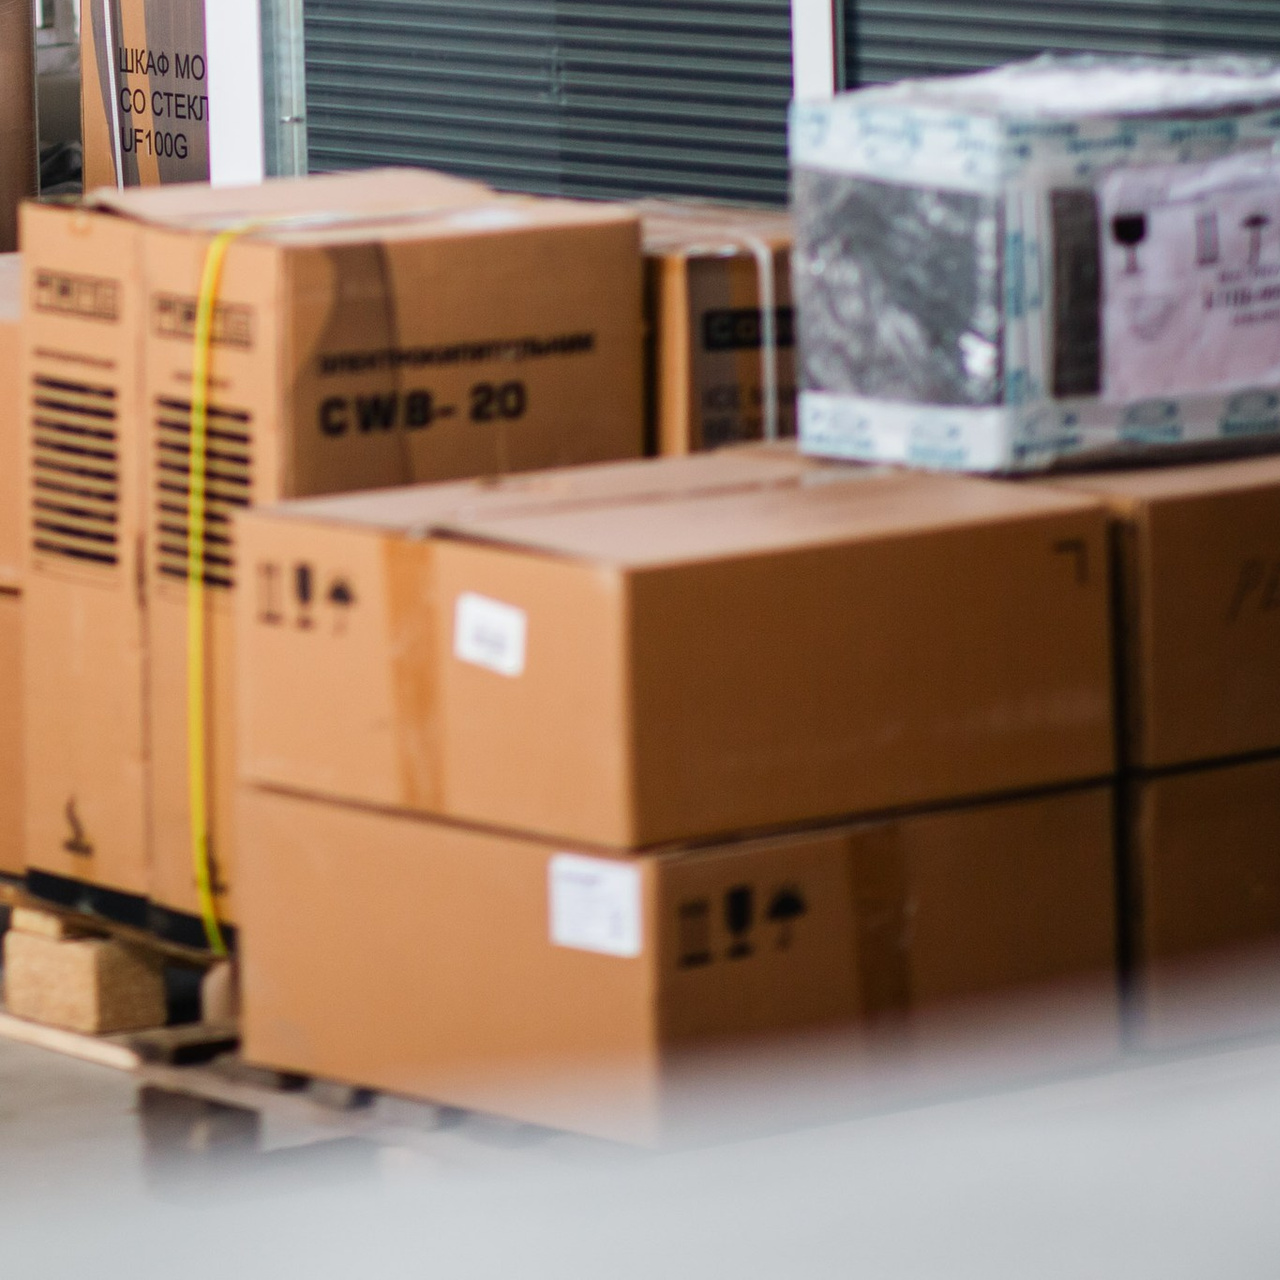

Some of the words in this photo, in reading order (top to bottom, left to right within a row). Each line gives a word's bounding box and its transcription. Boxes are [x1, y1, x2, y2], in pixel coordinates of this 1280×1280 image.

[119, 47, 169, 77] ШКАФ
[175, 53, 206, 81] МО
[120, 88, 146, 114] СО
[151, 91, 209, 122] СТЕКЛ
[121, 127, 188, 159] UF100G
